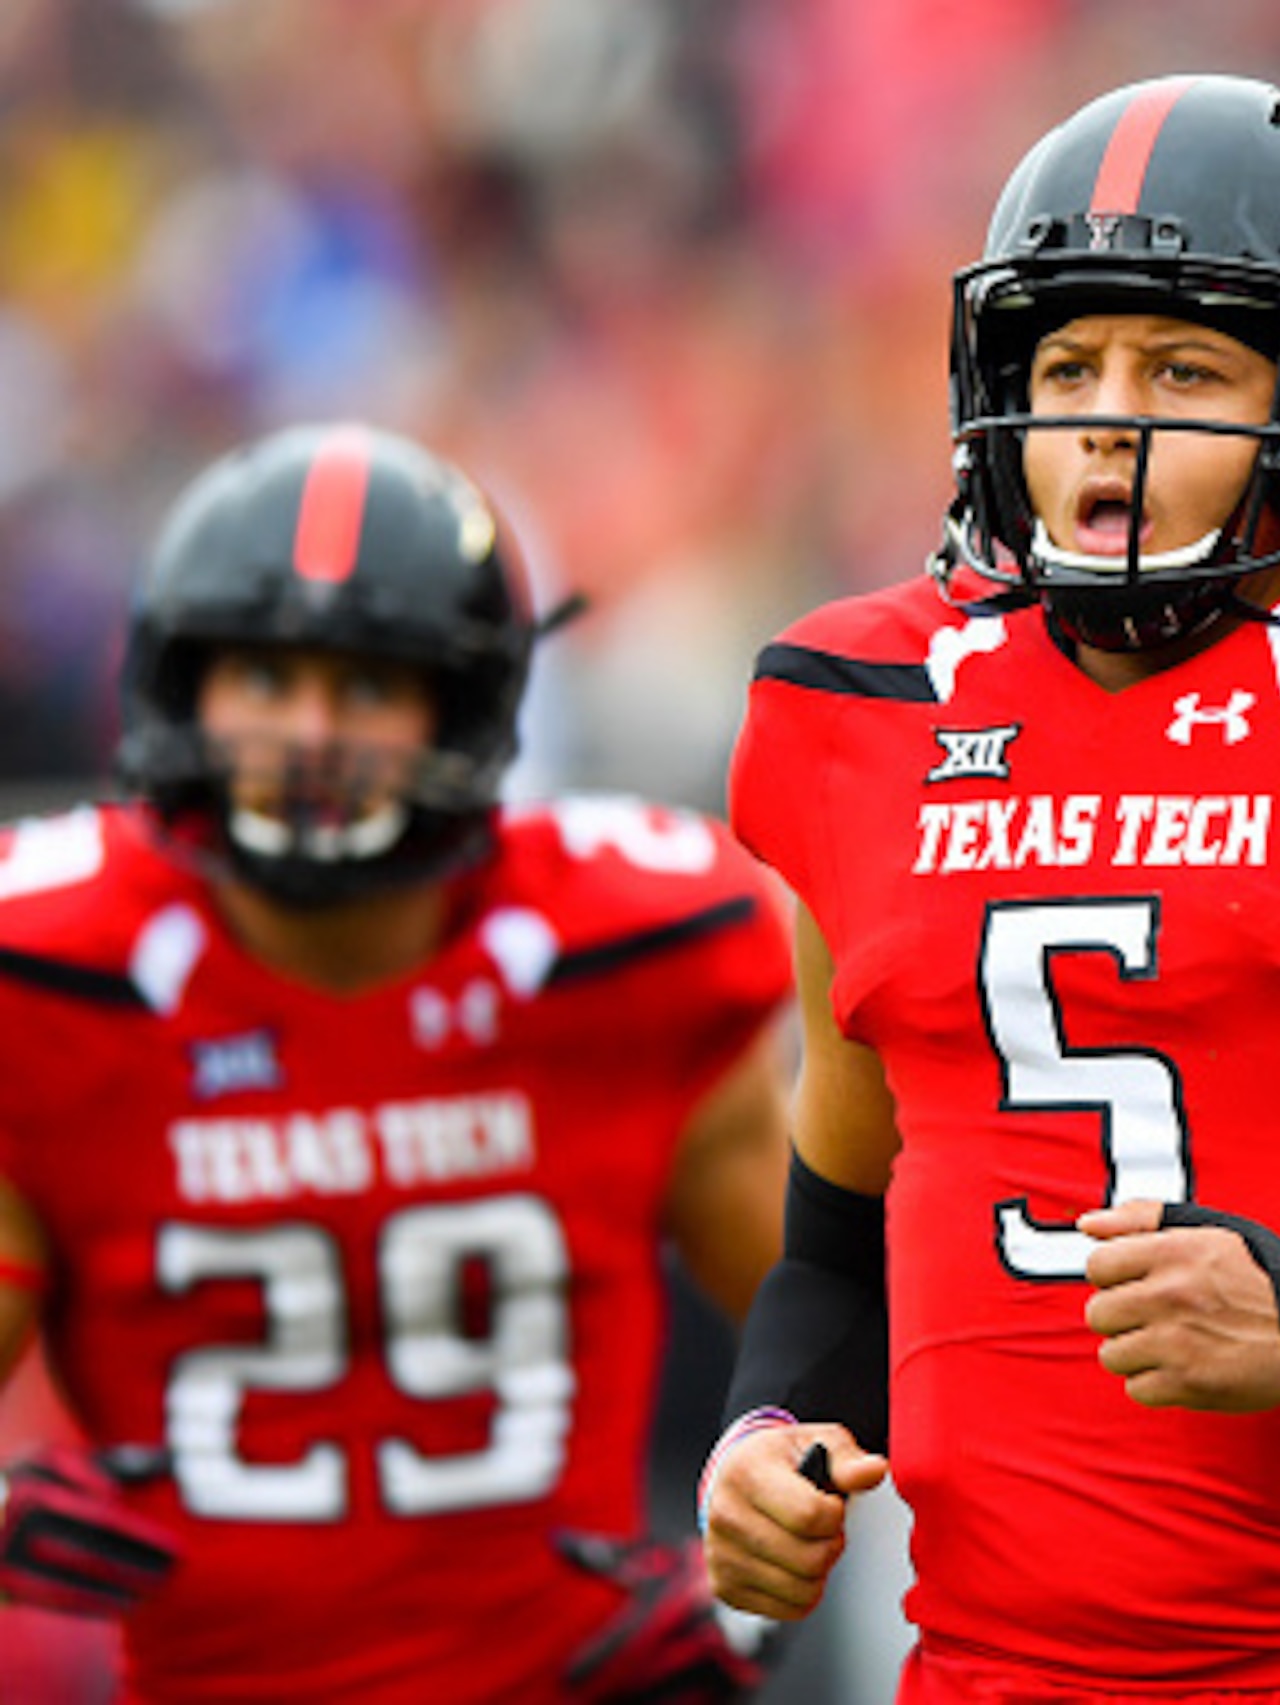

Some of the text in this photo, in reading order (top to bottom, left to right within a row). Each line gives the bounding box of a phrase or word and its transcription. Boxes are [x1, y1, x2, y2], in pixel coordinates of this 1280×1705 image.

[912, 795, 1272, 874] TEXAS TECH
[168, 1090, 536, 1203] TEXAS TECH
[976, 895, 1195, 1282] 5
[157, 1194, 576, 1522] 29
